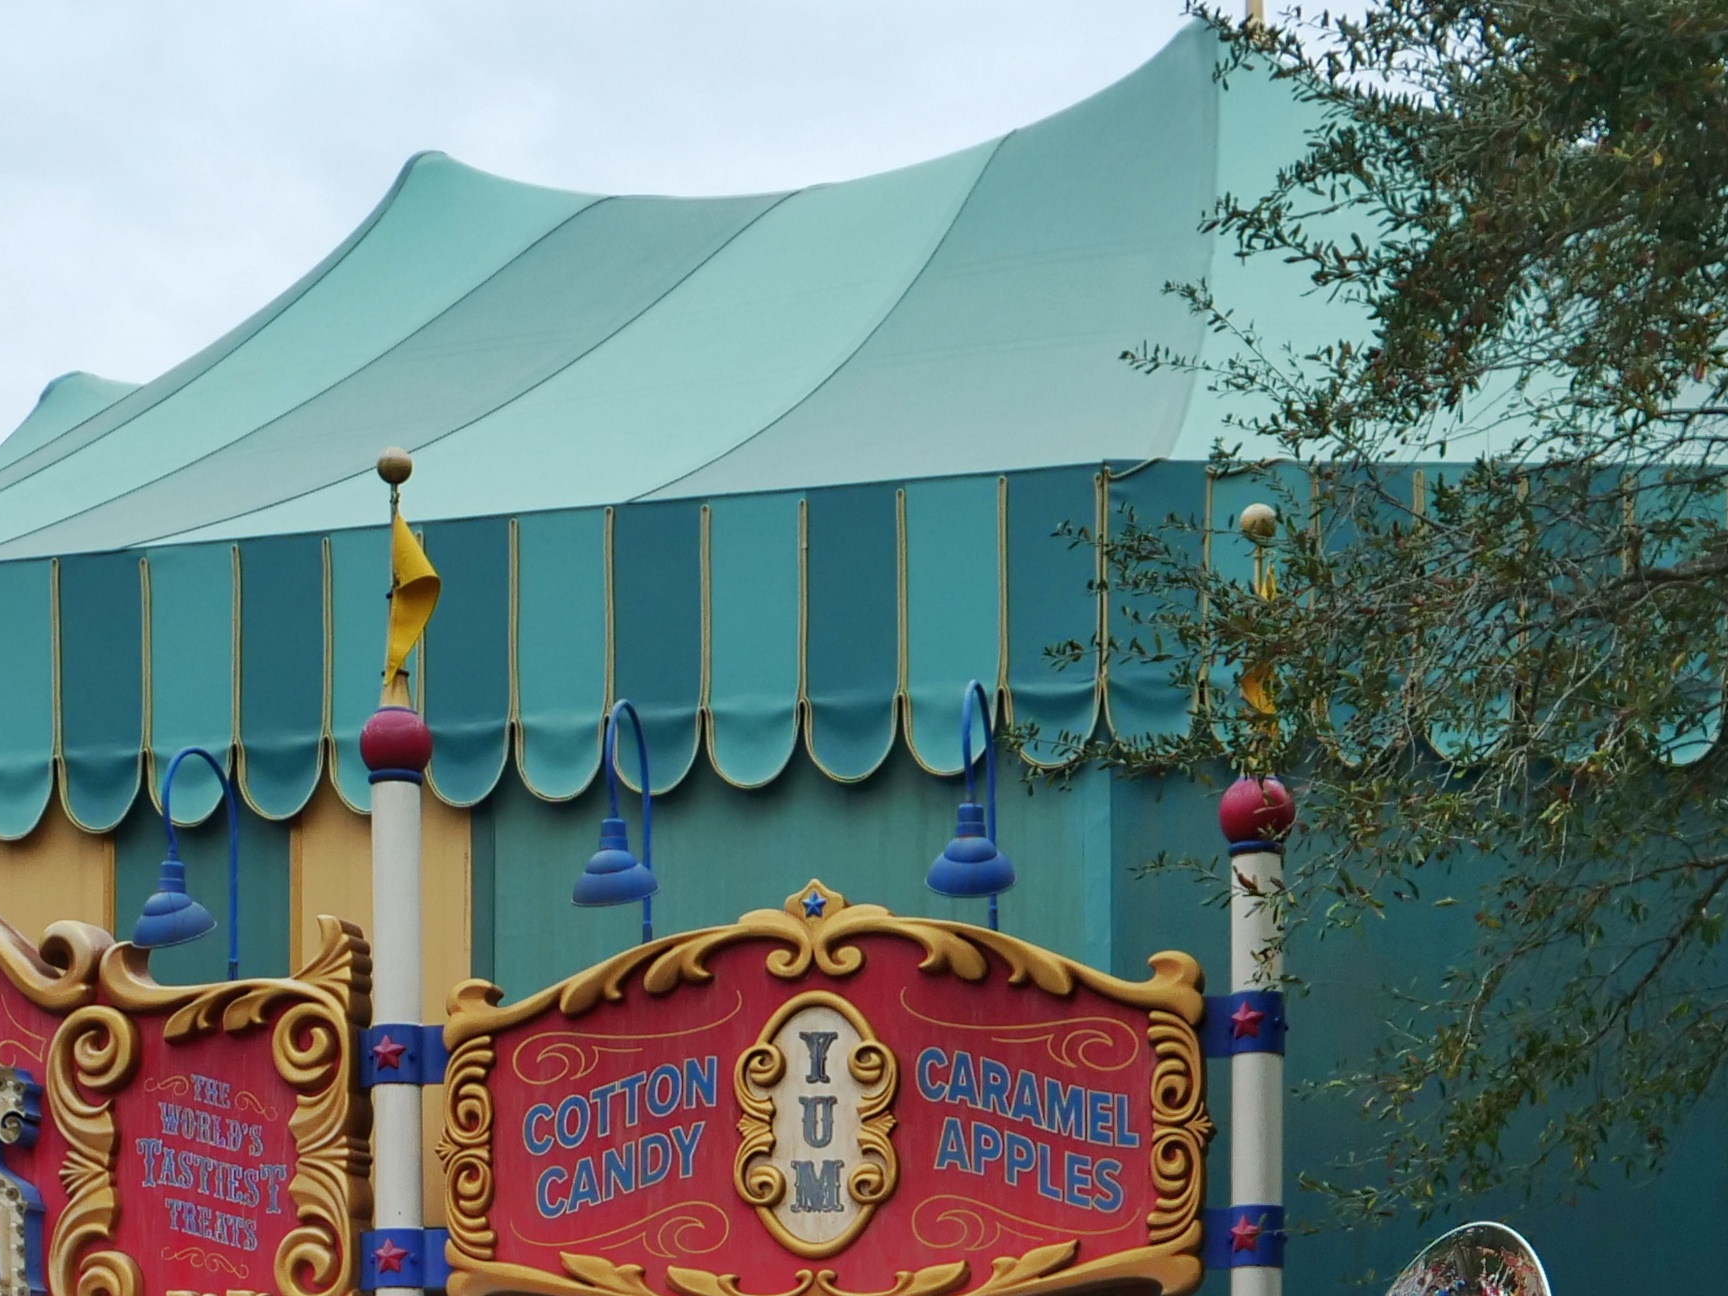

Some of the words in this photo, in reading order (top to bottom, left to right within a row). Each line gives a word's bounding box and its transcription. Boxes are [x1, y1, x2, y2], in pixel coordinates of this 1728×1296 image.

[158, 1101, 264, 1157] WORLD'S
[190, 1073, 231, 1109] THE
[522, 1055, 717, 1157] COTTON
[790, 1031, 845, 1213] YUM
[915, 1046, 1140, 1149] CARAMEL
[136, 1138, 287, 1215] TASTIEST
[536, 1120, 703, 1220] CANDY
[934, 1116, 1126, 1213] APPLES
[165, 1198, 257, 1250] TREATS
